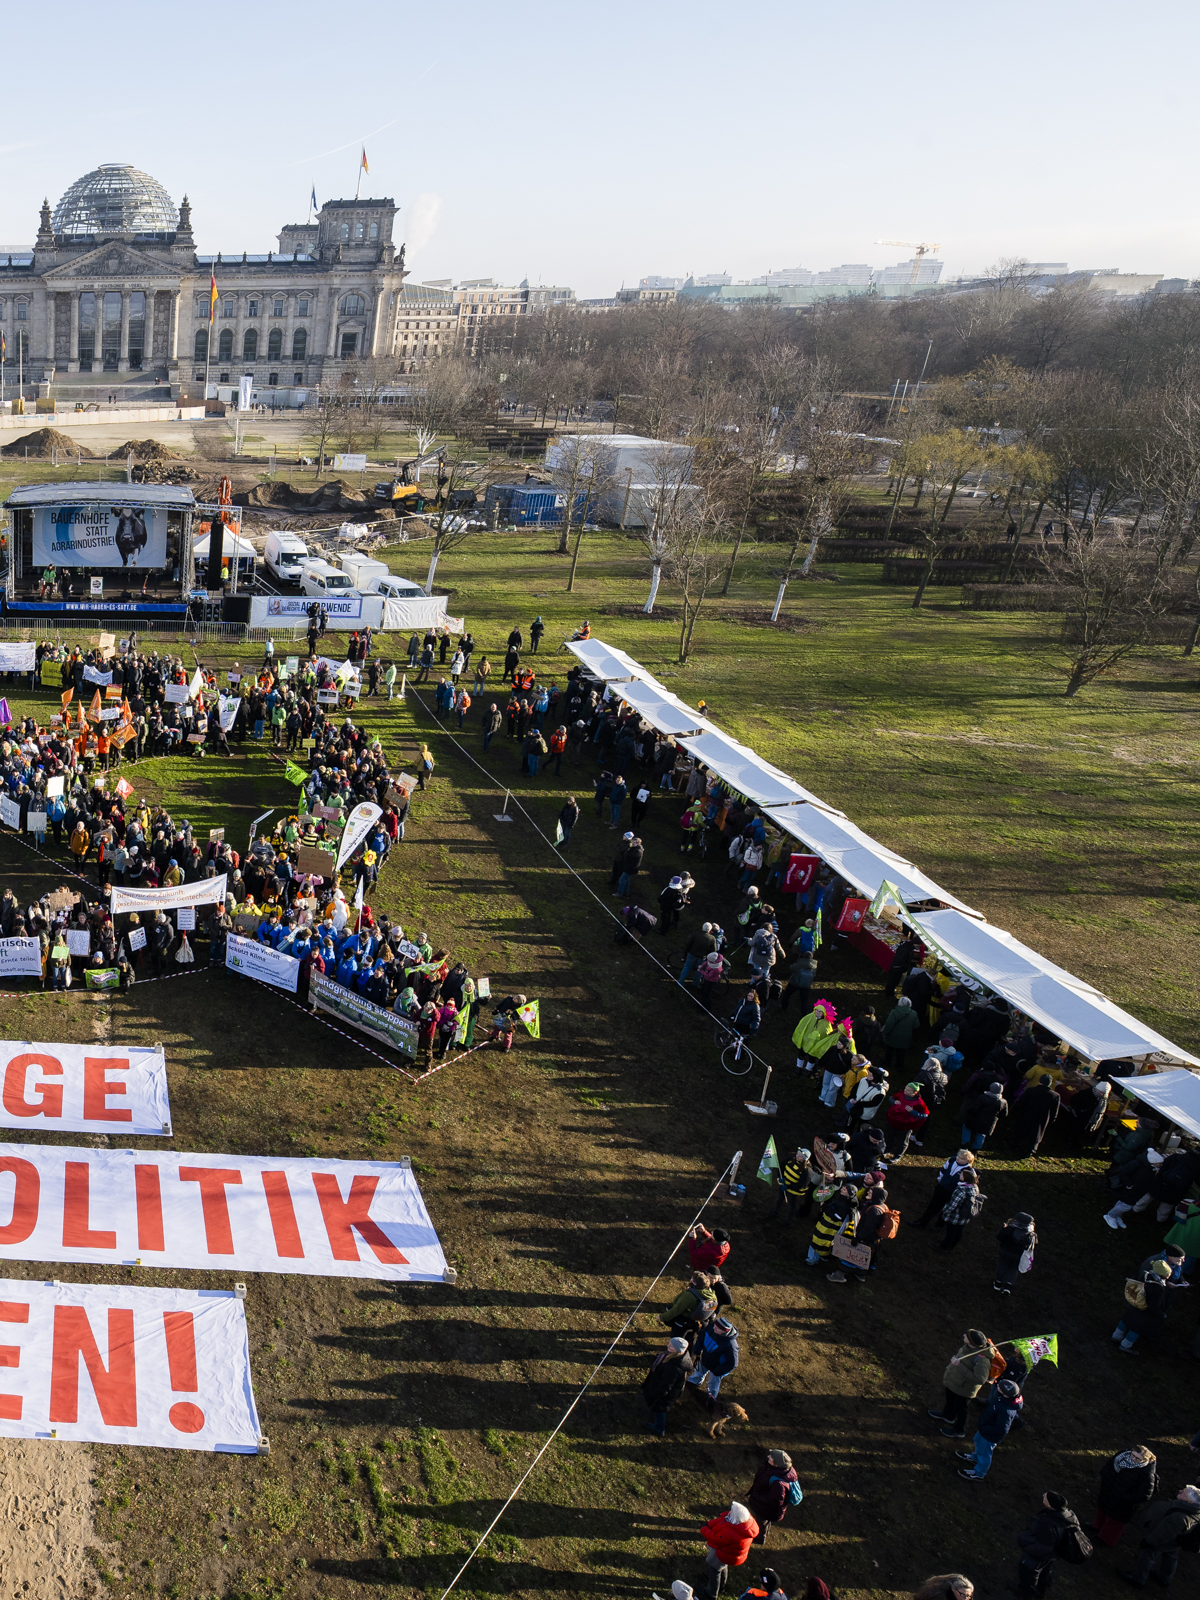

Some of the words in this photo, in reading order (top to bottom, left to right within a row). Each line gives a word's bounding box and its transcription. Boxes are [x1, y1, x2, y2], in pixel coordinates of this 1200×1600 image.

[51, 511, 110, 525] BAUERNHÖFE
[85, 526, 108, 536] STATT
[51, 536, 115, 552] AGRARINDUSTRIE!
[314, 973, 373, 1011] Landgrabbing
[374, 1006, 413, 1031] stoppen!
